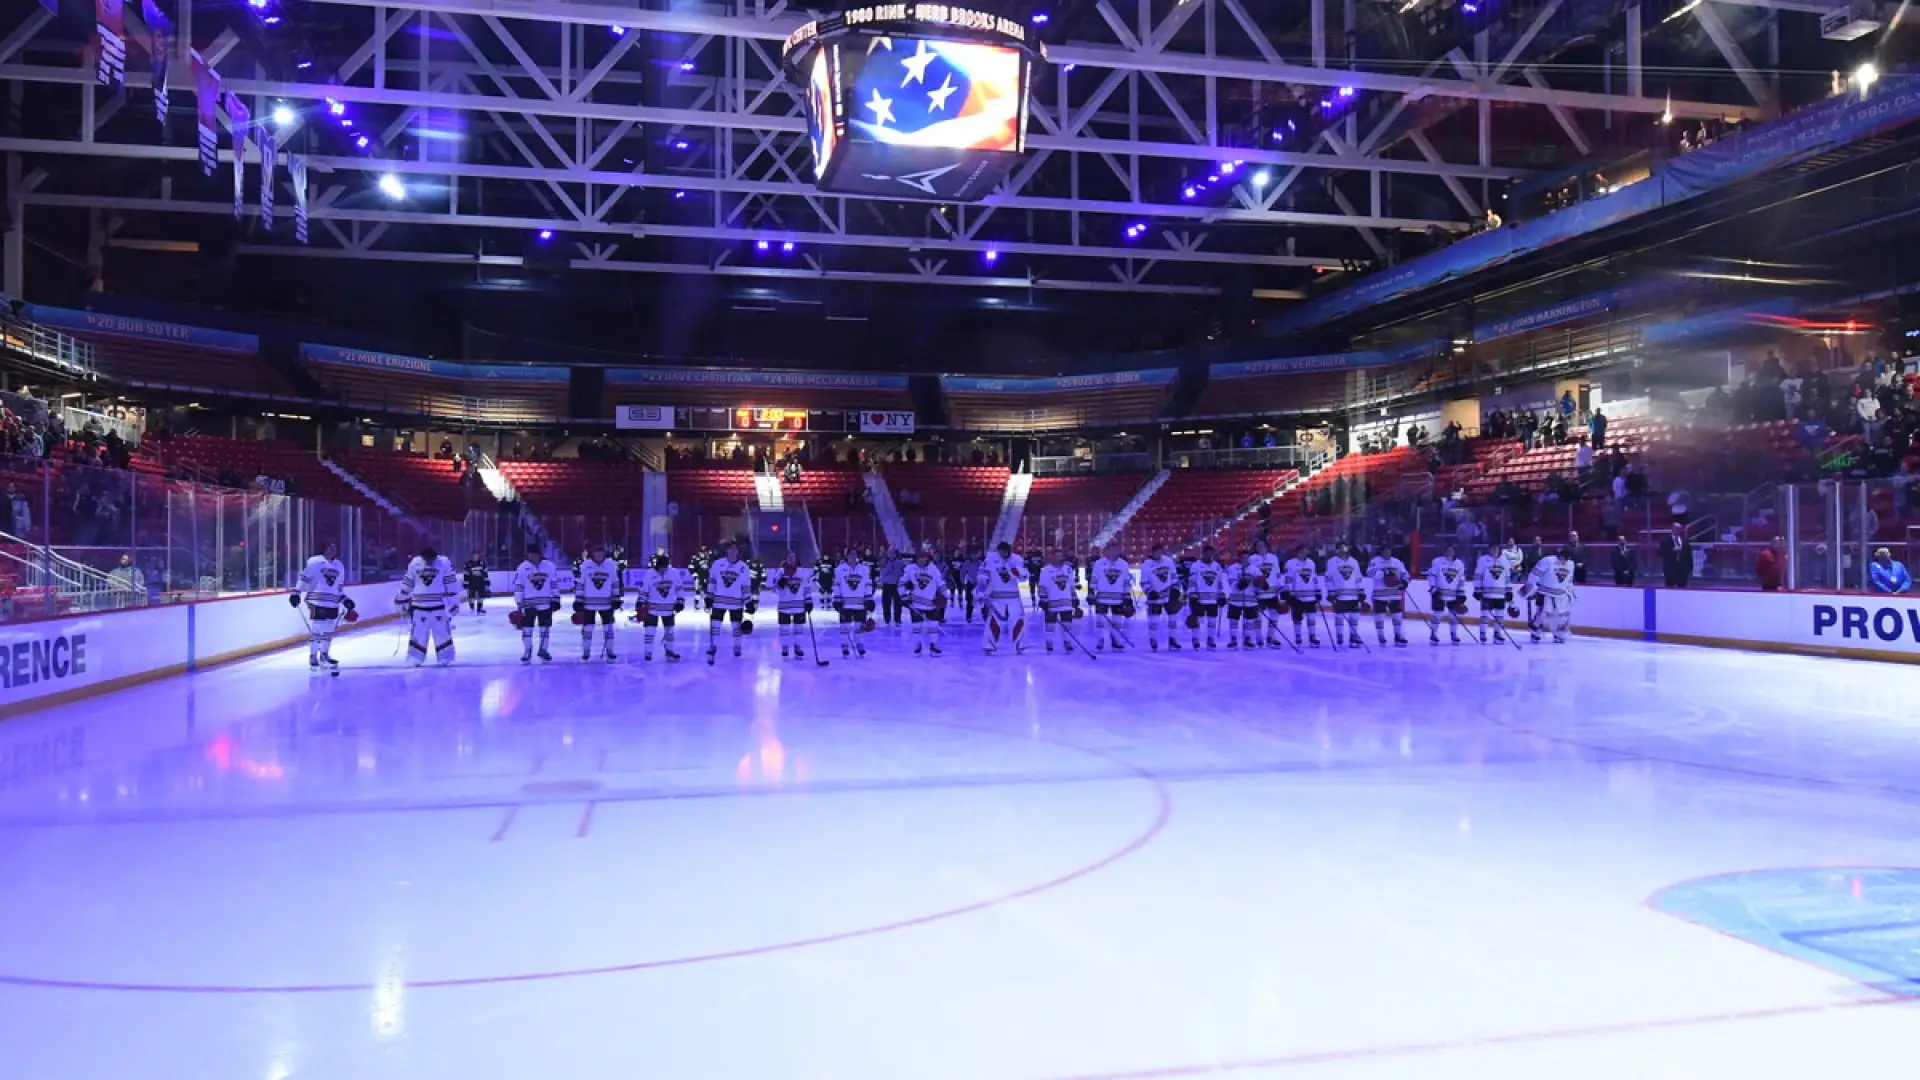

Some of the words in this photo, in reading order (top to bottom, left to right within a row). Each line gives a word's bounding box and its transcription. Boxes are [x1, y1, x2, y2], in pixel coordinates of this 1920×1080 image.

[1850, 101, 1889, 123] 1980
[117, 318, 143, 332] BOB
[146, 322, 189, 341] SUTER
[885, 412, 913, 427] NY
